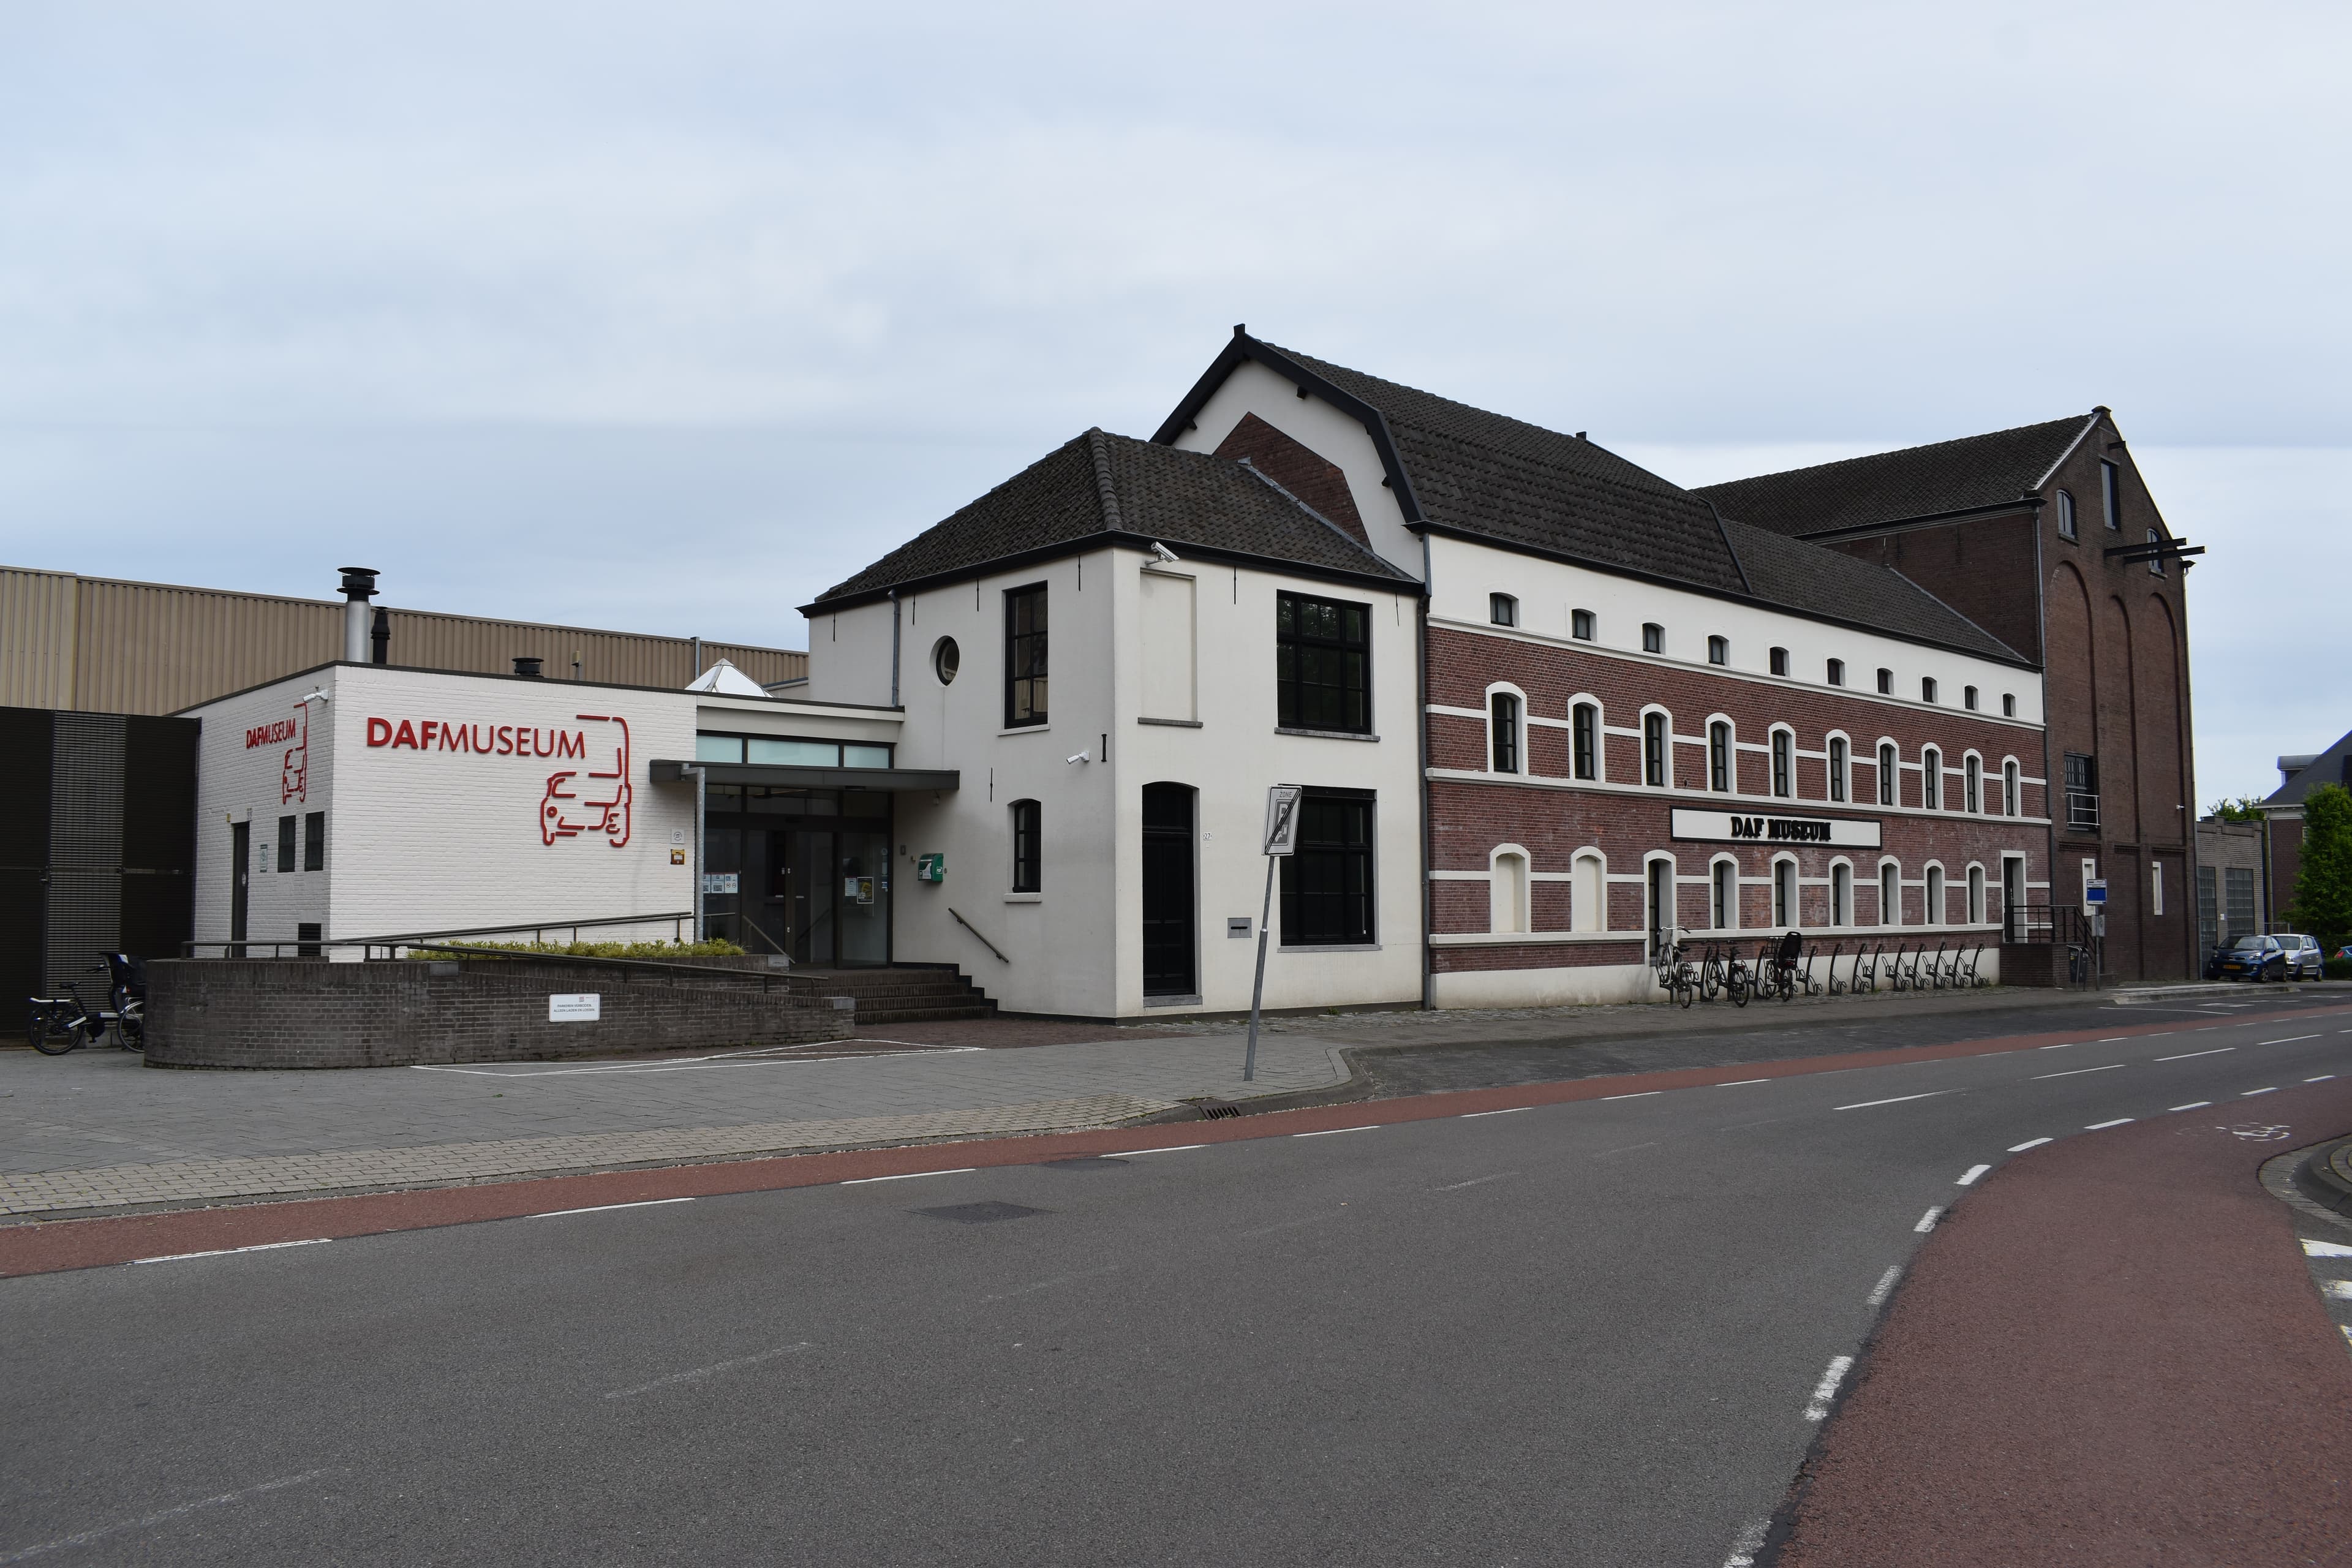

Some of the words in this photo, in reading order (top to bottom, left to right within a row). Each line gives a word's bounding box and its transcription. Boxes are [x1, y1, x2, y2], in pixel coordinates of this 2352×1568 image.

[246, 718, 296, 749] DAFMUSEUM
[367, 717, 585, 759] DAFMUSEUM
[1730, 816, 1764, 838] DAF
[1767, 819, 1831, 841] MUSEUM
